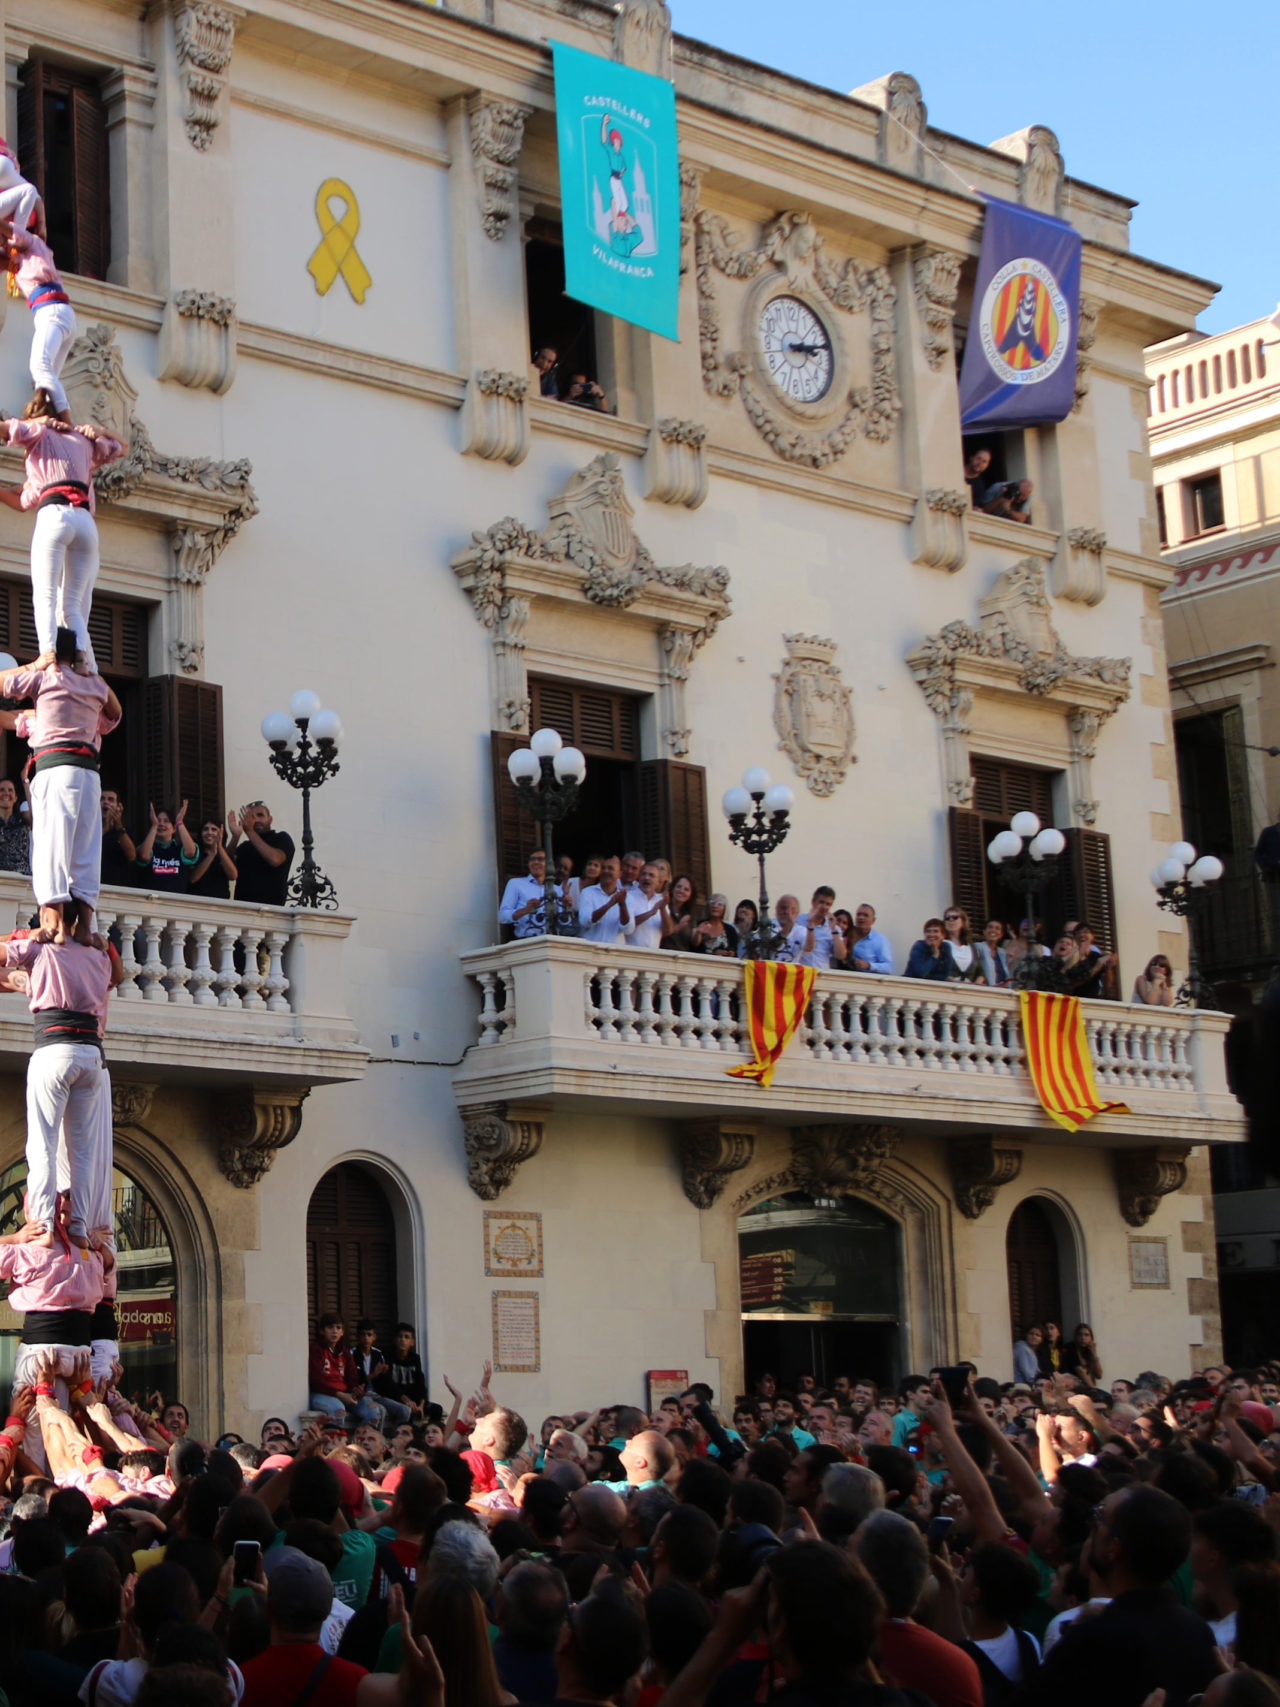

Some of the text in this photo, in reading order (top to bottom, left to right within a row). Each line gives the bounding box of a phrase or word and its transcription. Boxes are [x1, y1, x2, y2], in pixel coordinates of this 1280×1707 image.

[584, 95, 650, 128] CASTELLERS
[592, 244, 654, 277] VILAFRANCA
[992, 263, 1068, 324] COLLA CASTELLERA
[1021, 371, 1034, 381] DE
